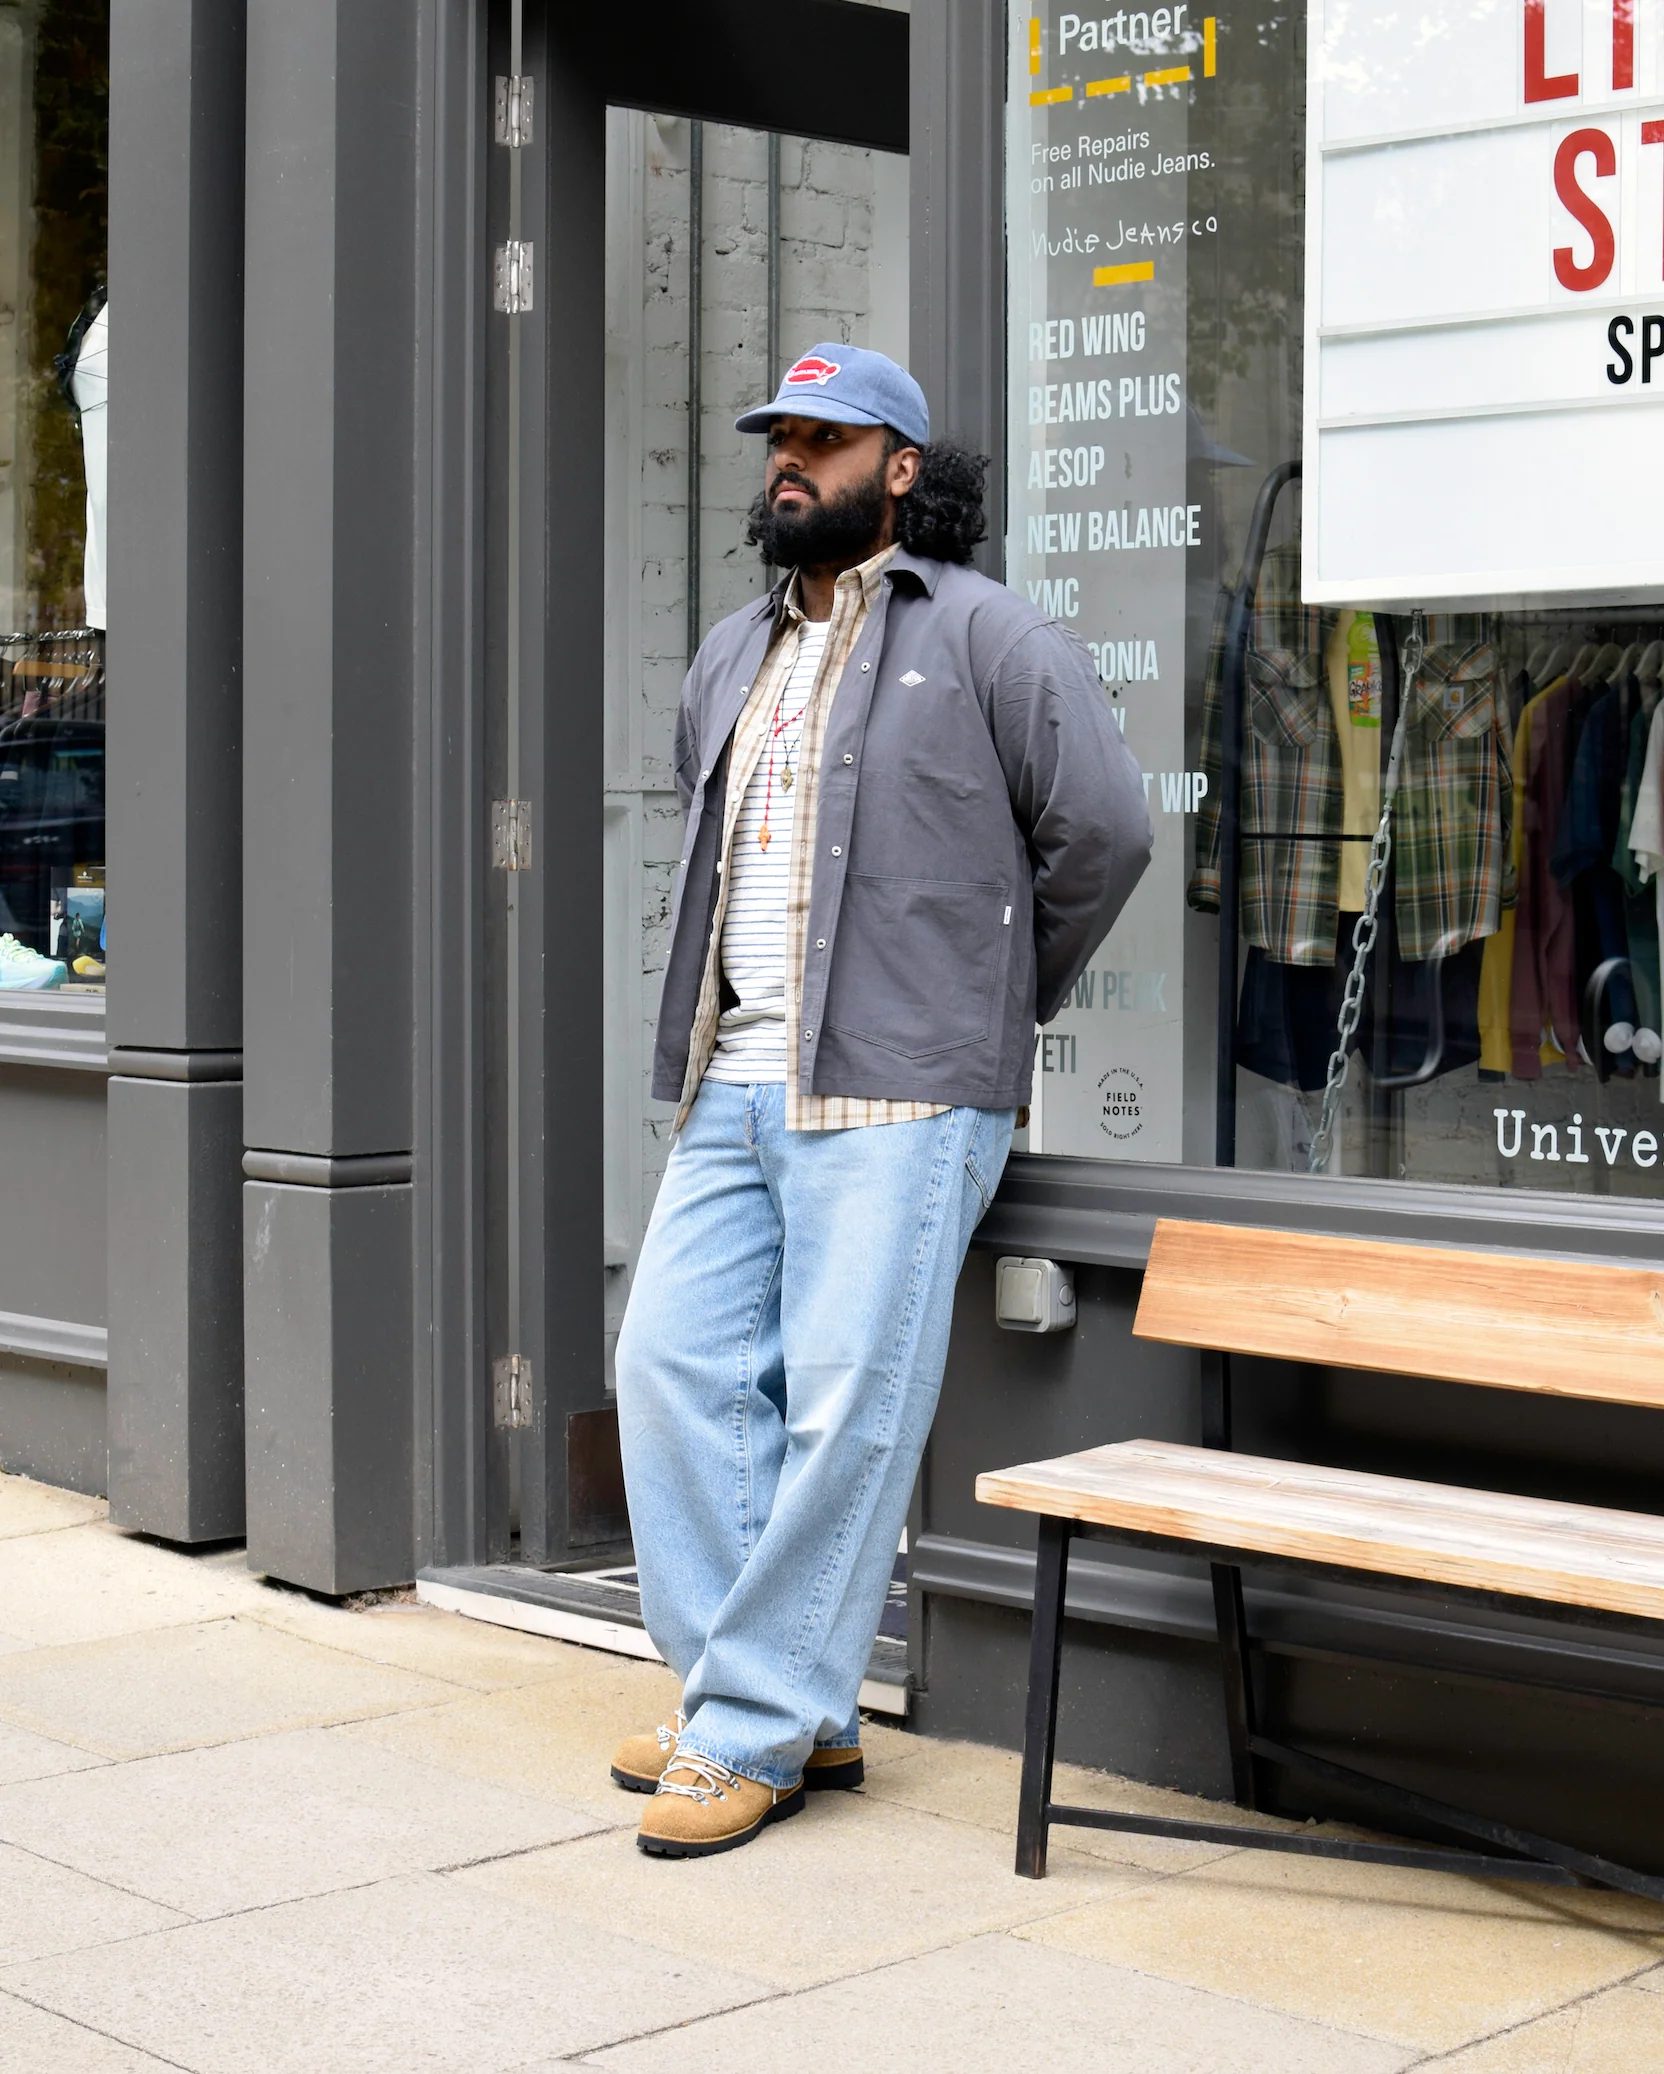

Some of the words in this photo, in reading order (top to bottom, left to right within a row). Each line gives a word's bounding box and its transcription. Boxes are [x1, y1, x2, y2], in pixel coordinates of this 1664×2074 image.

[1059, 4, 1188, 55] Partner
[1031, 143, 1071, 165] Free
[1078, 128, 1150, 158] Repairs
[1031, 174, 1053, 194] on
[1060, 165, 1081, 191] all
[1088, 157, 1146, 186] Nudie
[1151, 151, 1216, 177] Jeans.
[1028, 318, 1075, 361] RED
[1081, 310, 1146, 356] WING
[1606, 314, 1664, 385] SP
[1028, 379, 1112, 426] BEAMS
[1119, 372, 1181, 418] PLUS
[1027, 445, 1105, 490] AESOP
[1027, 512, 1081, 555] NEW
[1088, 504, 1202, 551] BALANCE
[1026, 577, 1080, 619] YMC
[1160, 771, 1209, 813] WIP
[1097, 1072, 1110, 1089] MADE
[1119, 1067, 1130, 1075] THE
[1106, 1092, 1137, 1103] FIELD
[1100, 1121, 1113, 1136] SOLD
[1113, 1132, 1131, 1140] RIGHT
[1131, 1122, 1143, 1136] HERE
[1103, 1106, 1140, 1116] NOTES
[1493, 1108, 1664, 1168] Unive
